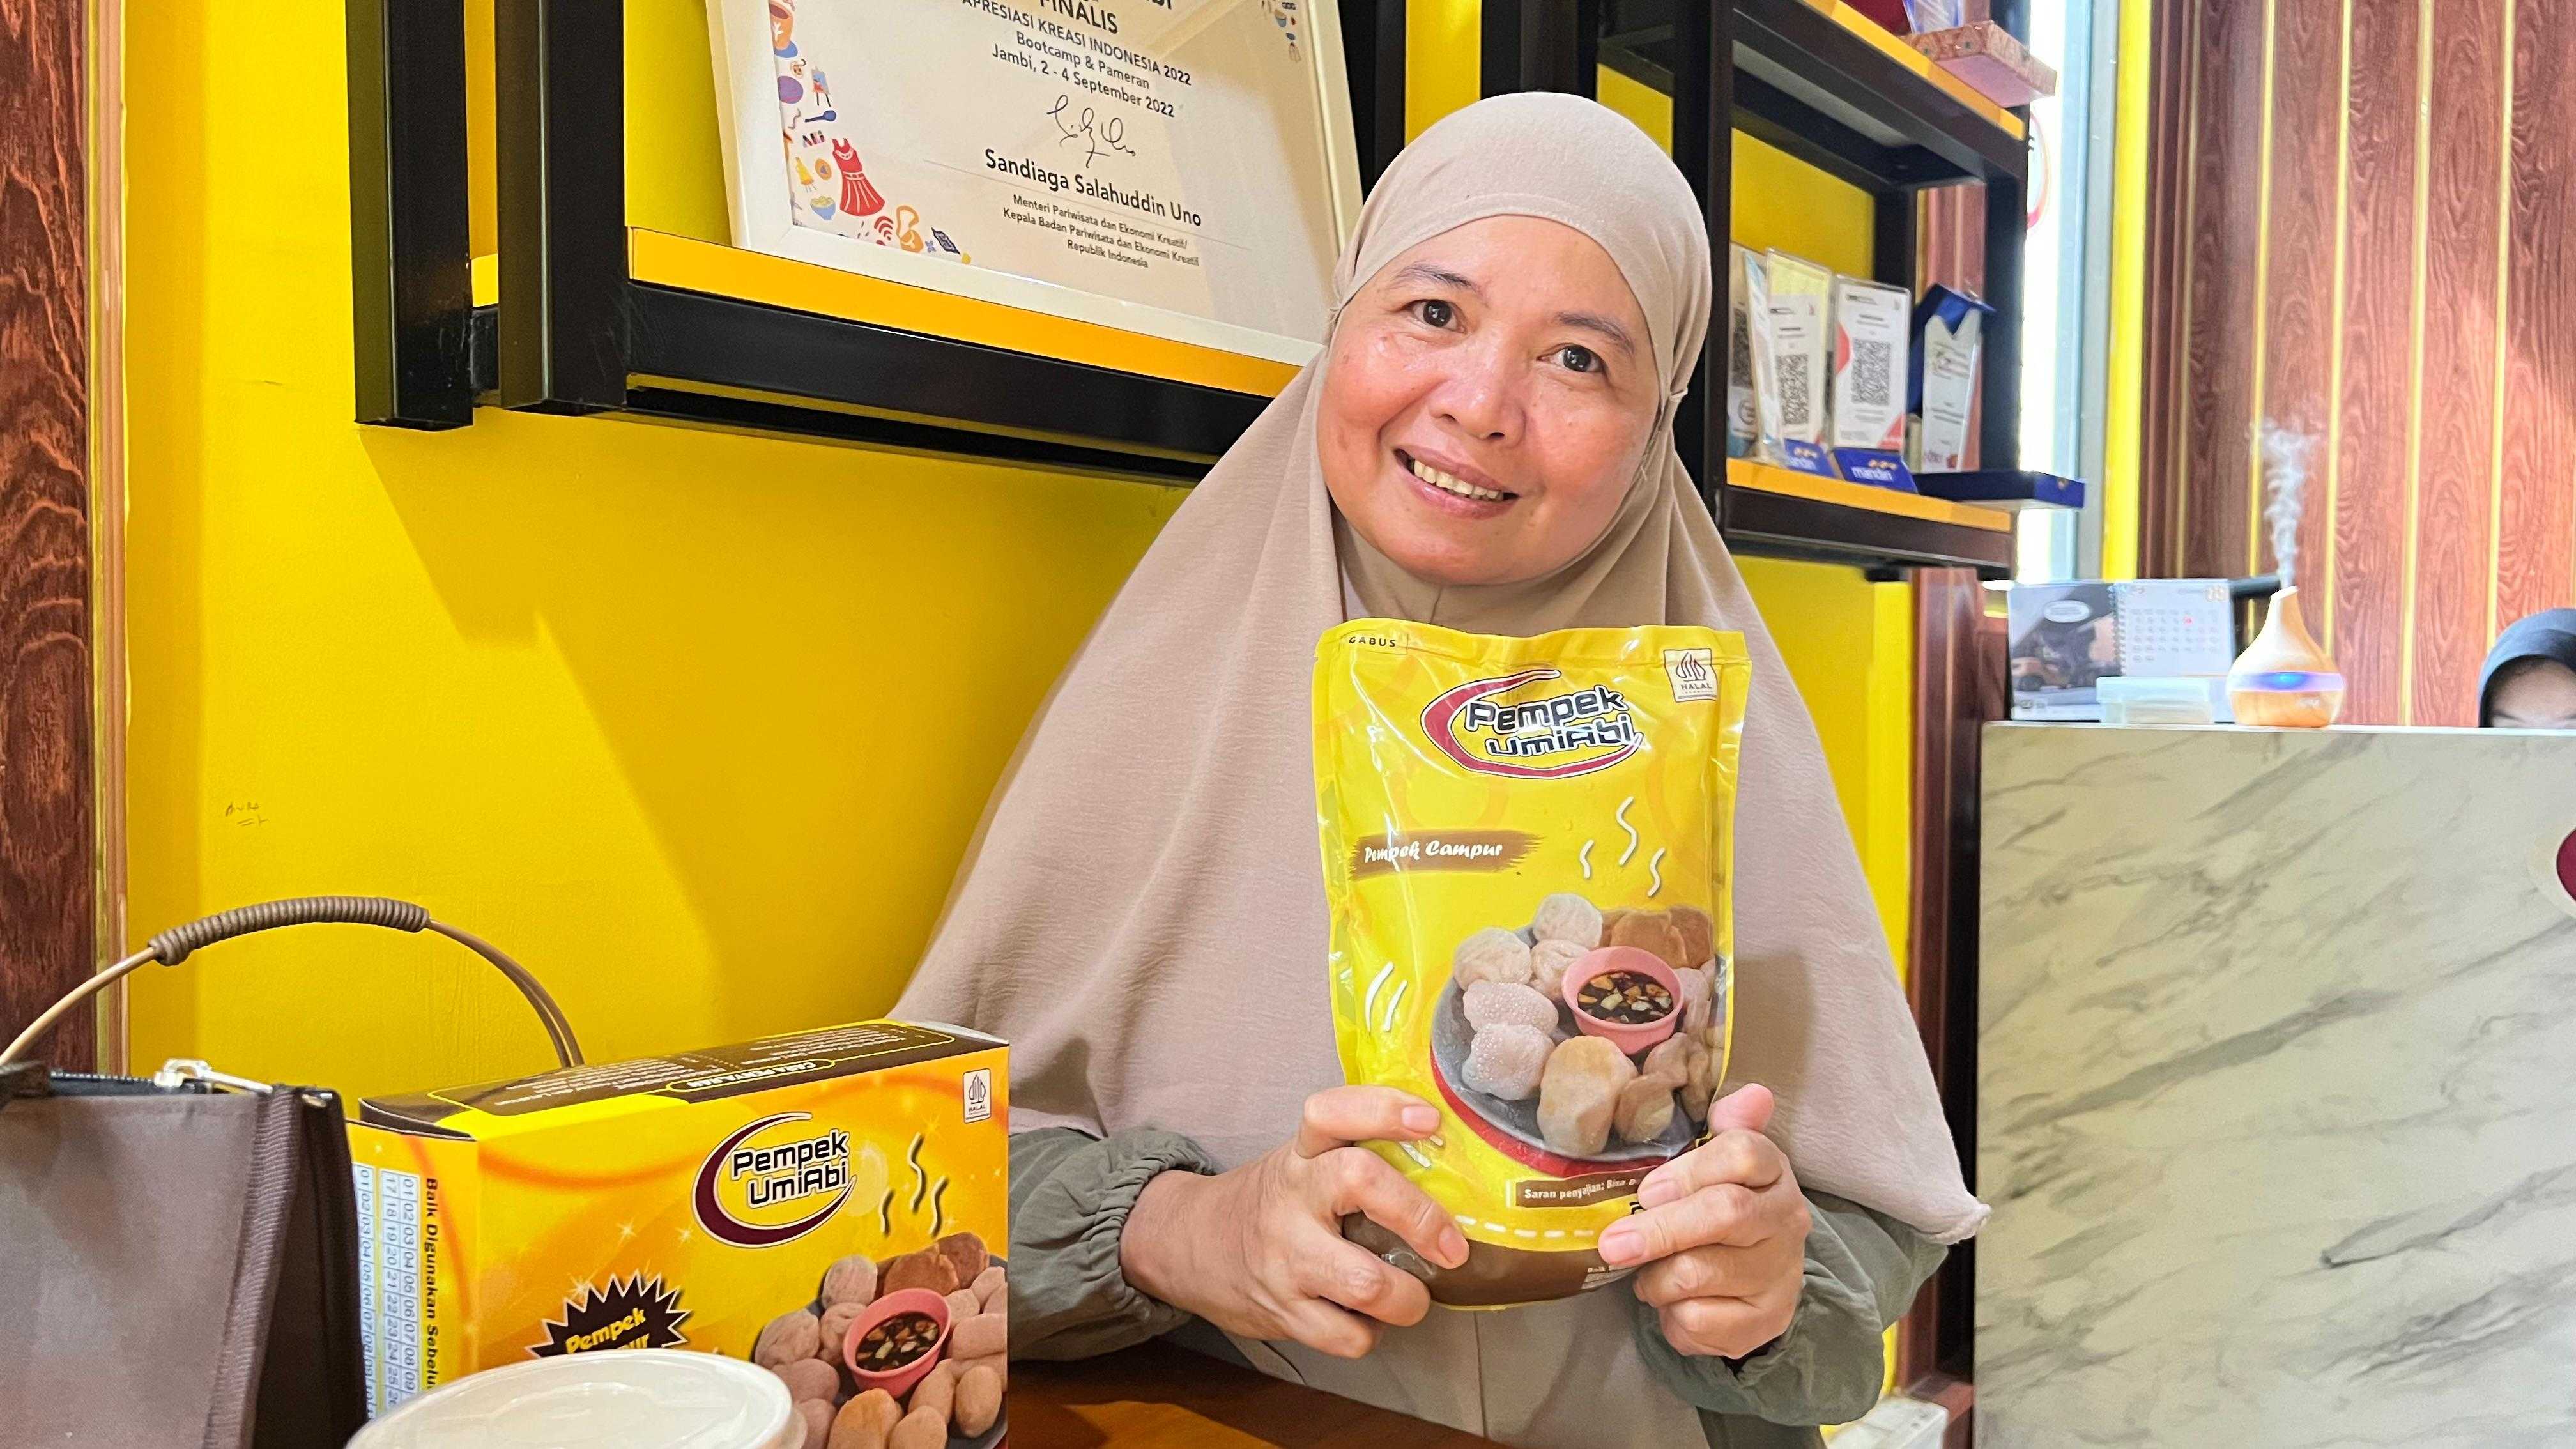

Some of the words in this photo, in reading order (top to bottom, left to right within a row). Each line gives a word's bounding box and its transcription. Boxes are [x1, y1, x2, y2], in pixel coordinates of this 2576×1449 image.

[1016, 31, 1081, 68] Bootcamp
[1085, 56, 1095, 70] &
[1098, 60, 1150, 89] Pameran
[1038, 18, 1086, 48] KREASI
[1089, 37, 1162, 75] INDONESIA
[1164, 65, 1192, 86] 2022
[992, 44, 1037, 72] Jambi,
[1040, 61, 1049, 75] 2
[1061, 68, 1070, 81] 4
[1073, 72, 1142, 107] September
[1145, 96, 1175, 118] 2022
[985, 148, 1070, 192] Sandiaga
[1075, 174, 1165, 217] Salahuddin
[1170, 201, 1202, 226] Uno
[1013, 194, 1050, 213] Menteri
[1052, 204, 1098, 226] Pariwisata
[1101, 217, 1117, 231] dan
[1119, 222, 1156, 241] Ekonomi
[1003, 206, 1036, 225] Kepala
[1038, 216, 1067, 233] Badan
[1070, 224, 1115, 245] Pariwisata
[1117, 236, 1133, 250] dan
[1134, 241, 1170, 259] Ekonomi
[1067, 239, 1106, 258] Republik
[1108, 250, 1149, 268] Indonesia
[1349, 636, 1396, 647] GABUS
[1680, 682, 1713, 691] HALAL
[1467, 686, 1628, 729] Pempek
[1364, 840, 1420, 863] Pempek
[1425, 839, 1503, 859] Campur
[733, 1131, 848, 1177] Pempek
[360, 1169, 369, 1186] 01
[386, 1178, 397, 1193] 17
[403, 1178, 414, 1195] 01
[749, 1161, 847, 1205] UmiAbi
[426, 1177, 438, 1217] Baik
[1524, 1188, 1556, 1199] Saran
[1559, 1182, 1604, 1200] penyajian:
[362, 1193, 371, 1211] 02
[386, 1202, 397, 1217] 18
[403, 1202, 414, 1221] 02
[362, 1216, 371, 1235] 03
[387, 1226, 397, 1241] 19
[403, 1227, 414, 1245] 03
[362, 1240, 371, 1258] 04
[387, 1247, 397, 1266] 20
[404, 1252, 414, 1268] 04
[387, 1271, 397, 1288] 21
[424, 1224, 439, 1319] Digunakan
[404, 1275, 415, 1293] 05
[388, 1294, 397, 1314] 22
[404, 1300, 415, 1317] 06
[388, 1318, 398, 1337] 23
[404, 1324, 415, 1342] 07
[565, 1307, 646, 1354] Pempek
[388, 1342, 398, 1361] 24
[404, 1347, 415, 1366] 08
[427, 1324, 440, 1389] Sebelu
[388, 1367, 398, 1386] 25
[405, 1372, 415, 1390] 09
